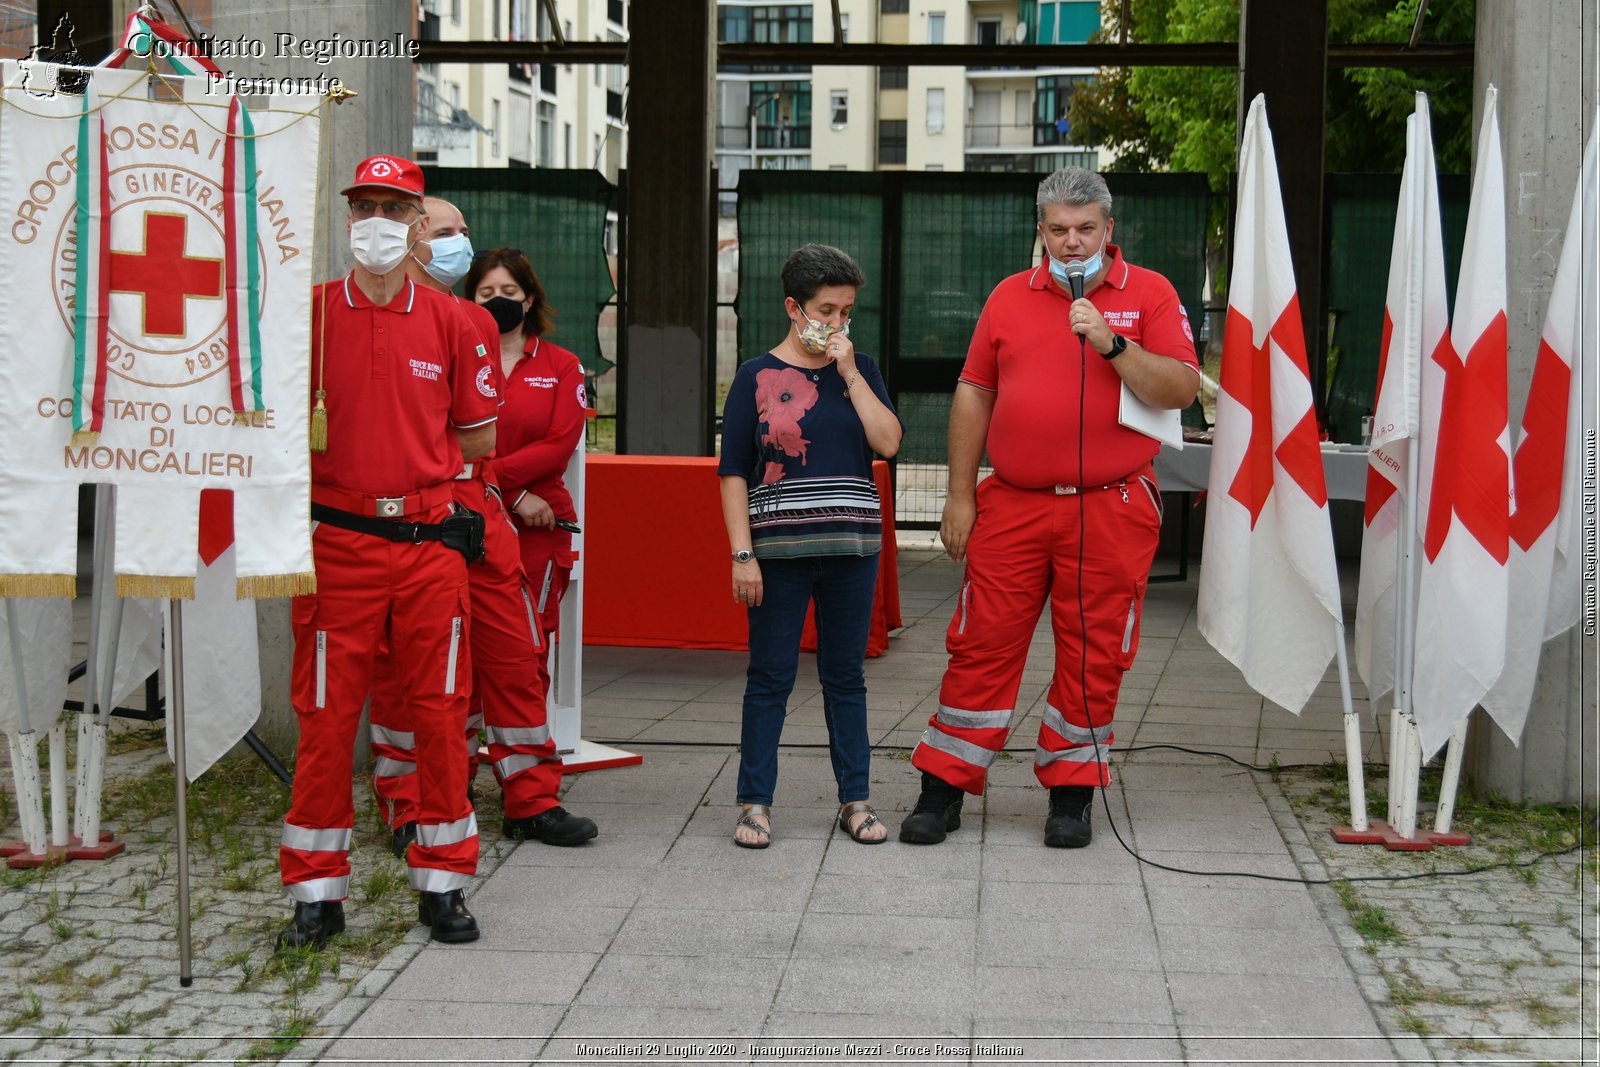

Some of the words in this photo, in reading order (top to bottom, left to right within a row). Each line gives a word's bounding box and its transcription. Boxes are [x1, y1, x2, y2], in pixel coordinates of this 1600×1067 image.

[11, 144, 78, 244] CROCE
[208, 138, 300, 265] IIANA
[125, 171, 225, 218] GINEVRA
[1103, 311, 1121, 319] CROCE
[1122, 311, 1140, 319] ROSSA
[1108, 319, 1133, 328] ITALIANA
[409, 358, 427, 369] CROCE
[37, 397, 171, 424] COTATO
[150, 426, 175, 447] DI
[64, 445, 253, 478] MONCALIERI
